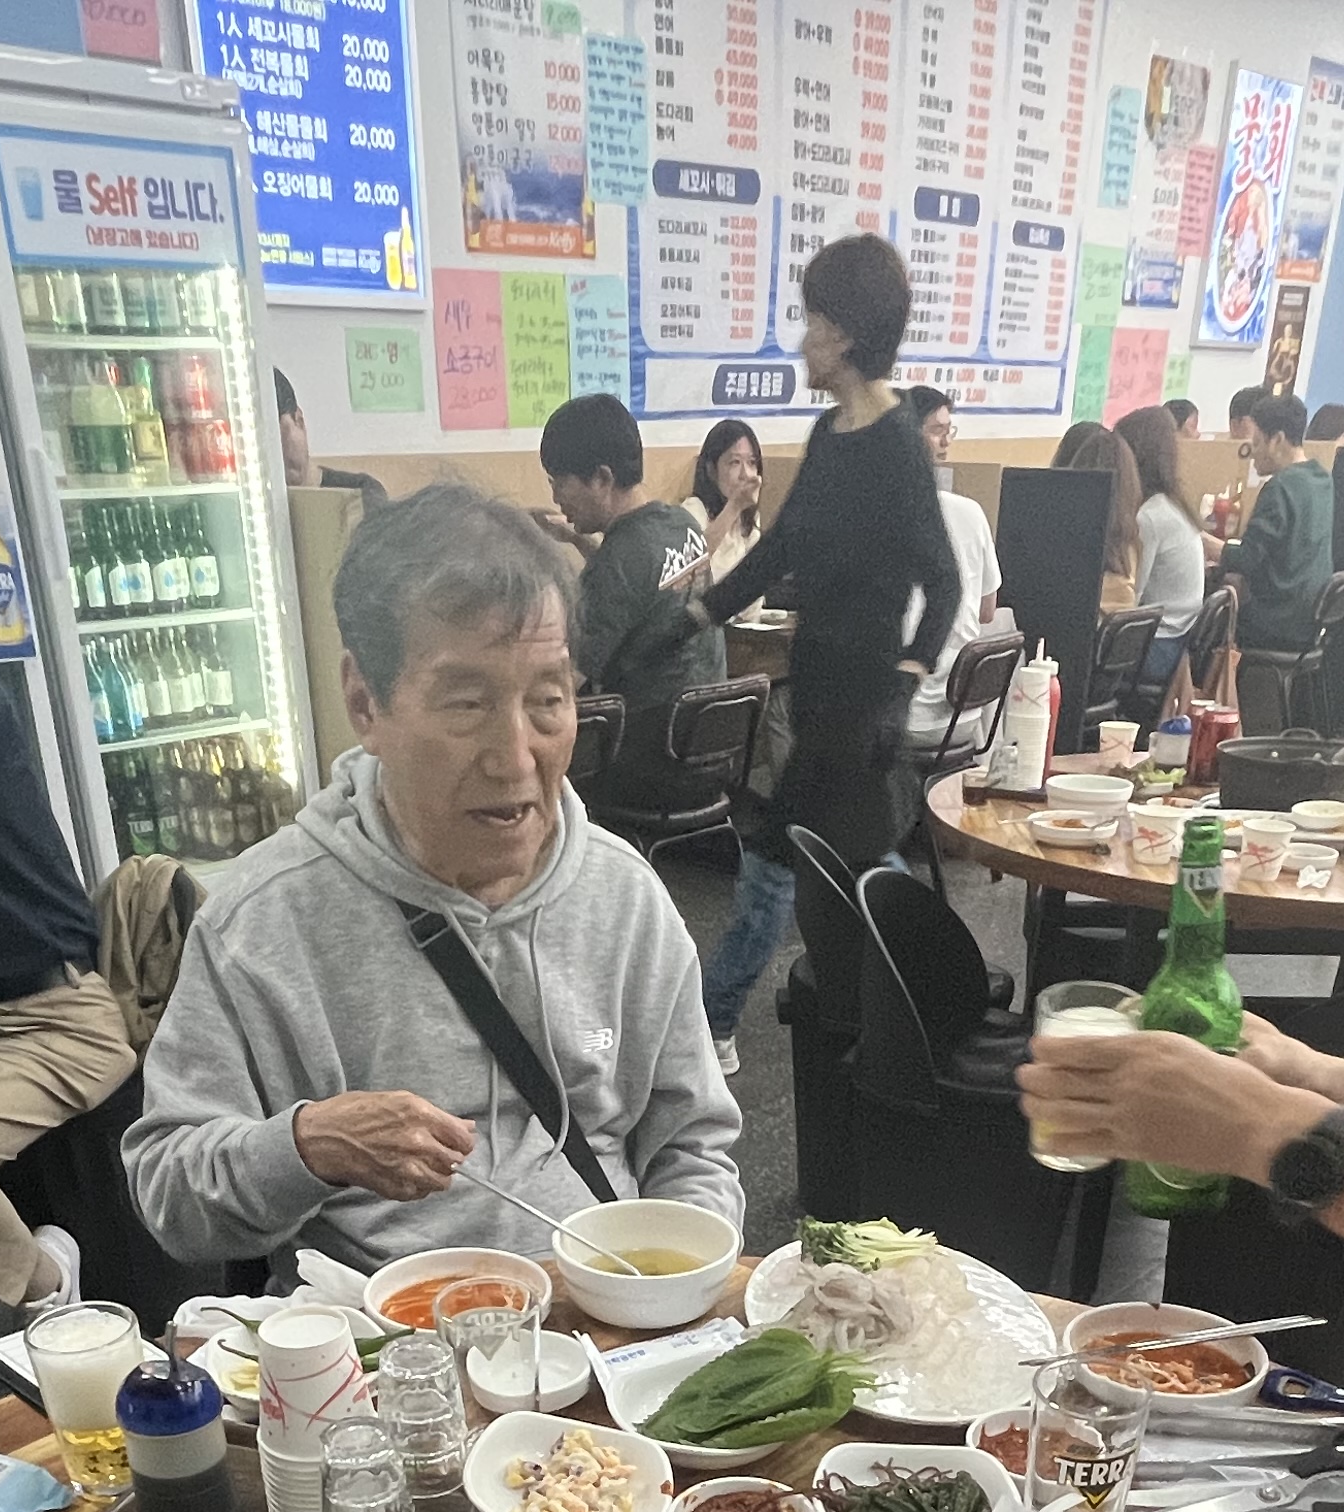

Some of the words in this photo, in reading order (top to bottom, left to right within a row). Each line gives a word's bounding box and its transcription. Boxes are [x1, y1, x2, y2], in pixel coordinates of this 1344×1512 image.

[248, 16, 320, 53] 세꼬시물회
[342, 34, 389, 63] 20,000
[794, 18, 833, 47] 광어+우럭
[250, 48, 309, 81] 전복물회
[345, 64, 391, 93] 20,000
[467, 47, 506, 75] 어묵탕
[544, 60, 581, 82] 10,000
[471, 77, 508, 107] 홍합탕
[656, 102, 694, 123] 도다리회
[349, 124, 396, 150] 20,000
[1234, 91, 1293, 191] 물회
[52, 169, 84, 215] 물
[86, 171, 139, 217] Self
[143, 177, 225, 223] 입니다.
[263, 170, 333, 201] 오징어물회
[354, 181, 400, 206] 20,000
[658, 218, 708, 237] 도다리세꼬시
[1053, 1456, 1136, 1487] TERRA
